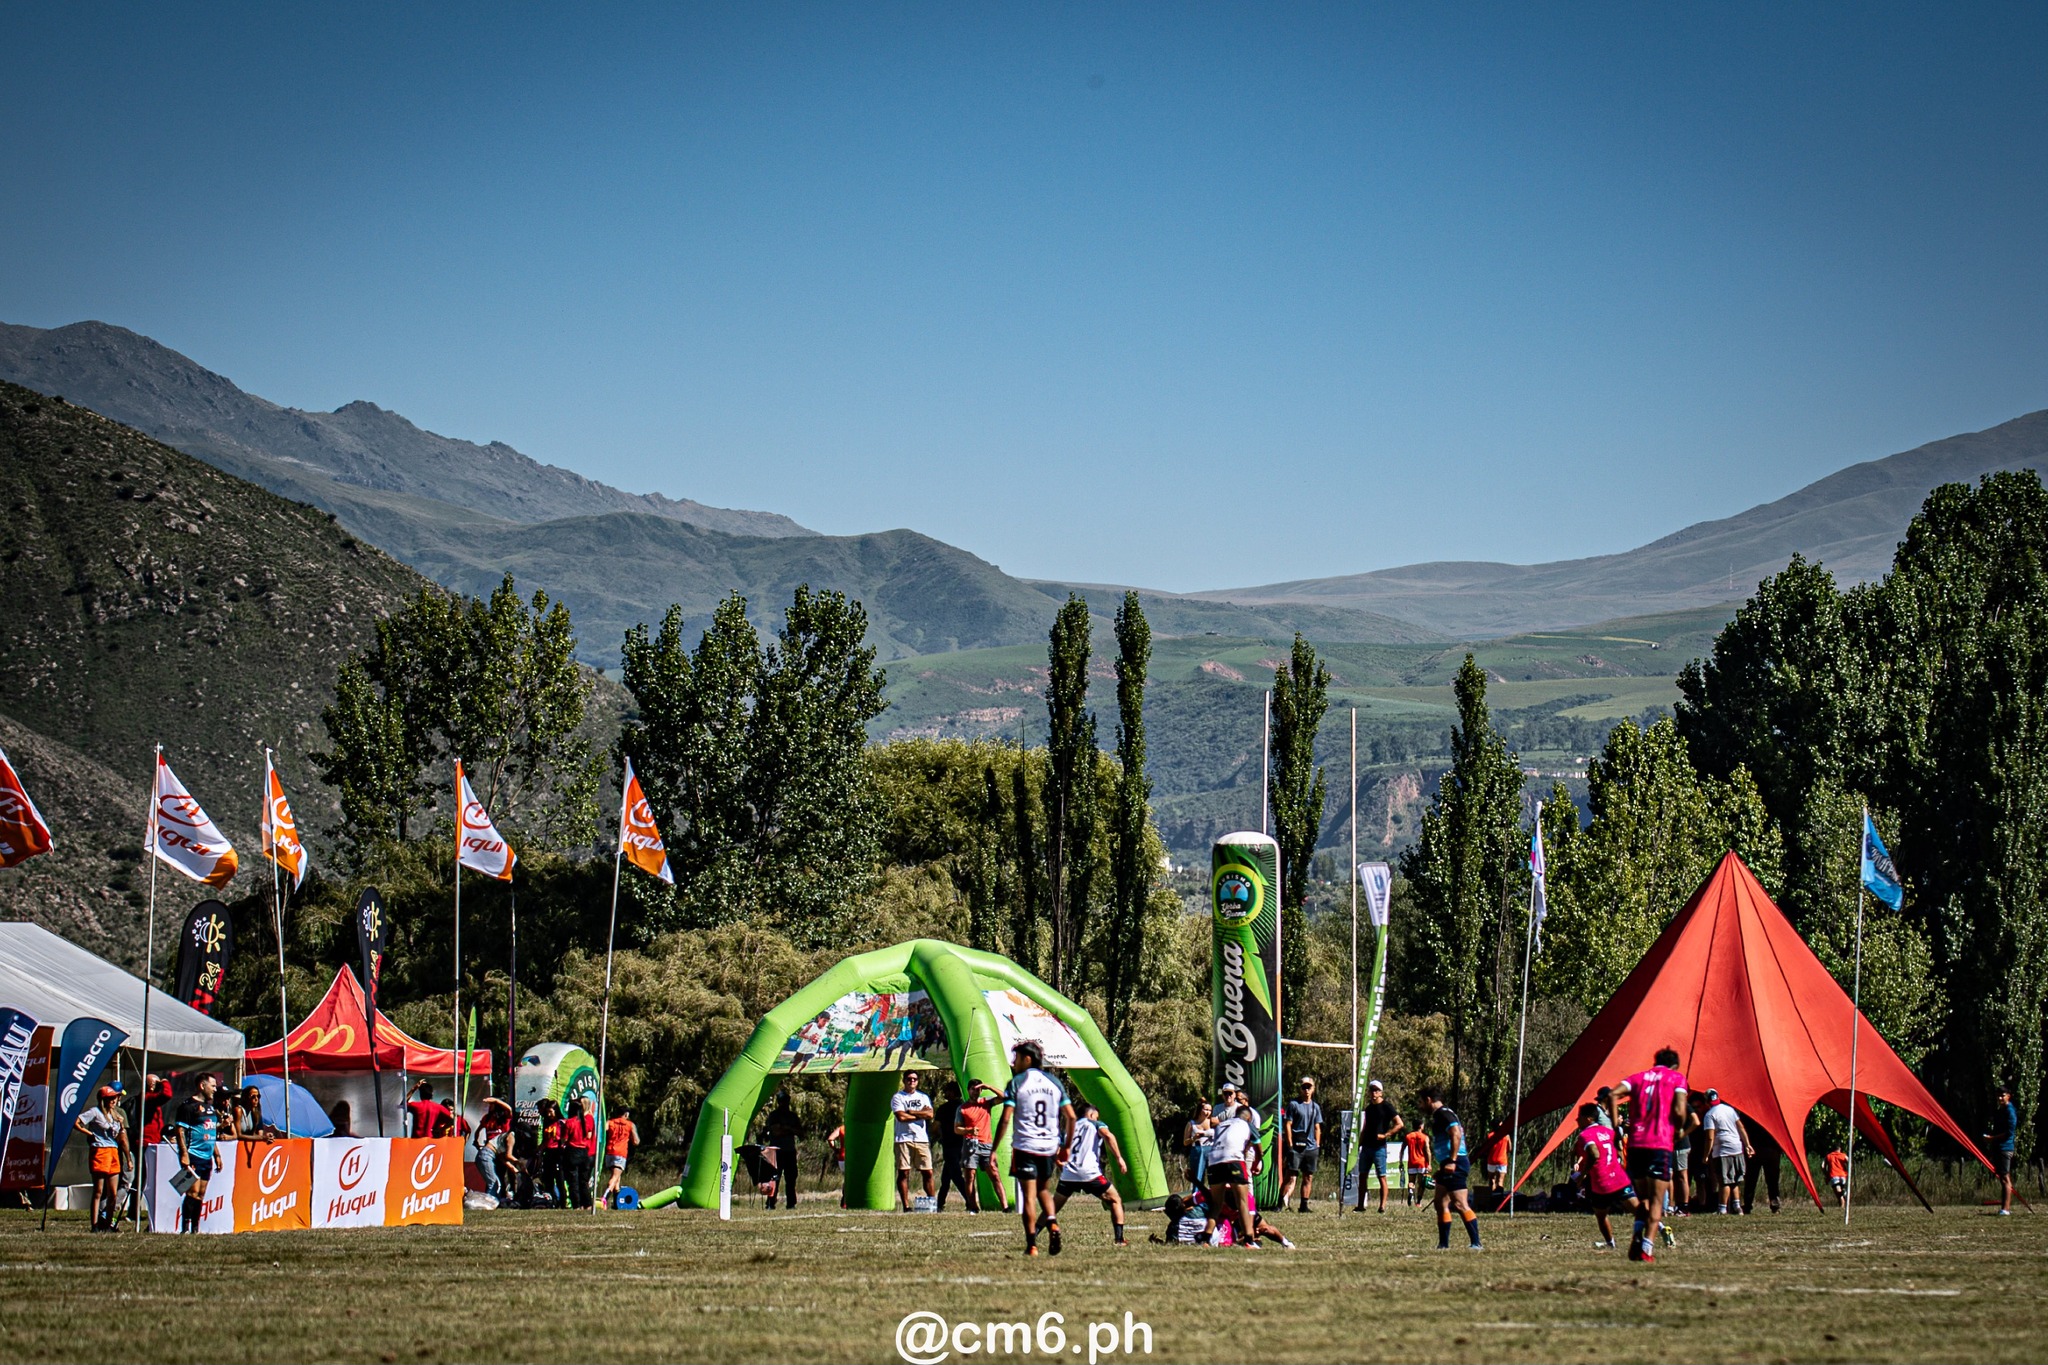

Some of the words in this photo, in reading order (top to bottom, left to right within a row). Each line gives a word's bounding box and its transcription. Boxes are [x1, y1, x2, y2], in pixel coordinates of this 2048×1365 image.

[1216, 940, 1257, 1062] Buena
[72, 1028, 112, 1082] Macro
[1034, 1100, 1047, 1128] 8
[1602, 1143, 1613, 1165] 7
[251, 1190, 298, 1226] Huqui
[327, 1190, 377, 1223] Huqui
[401, 1188, 450, 1219] Huqui
